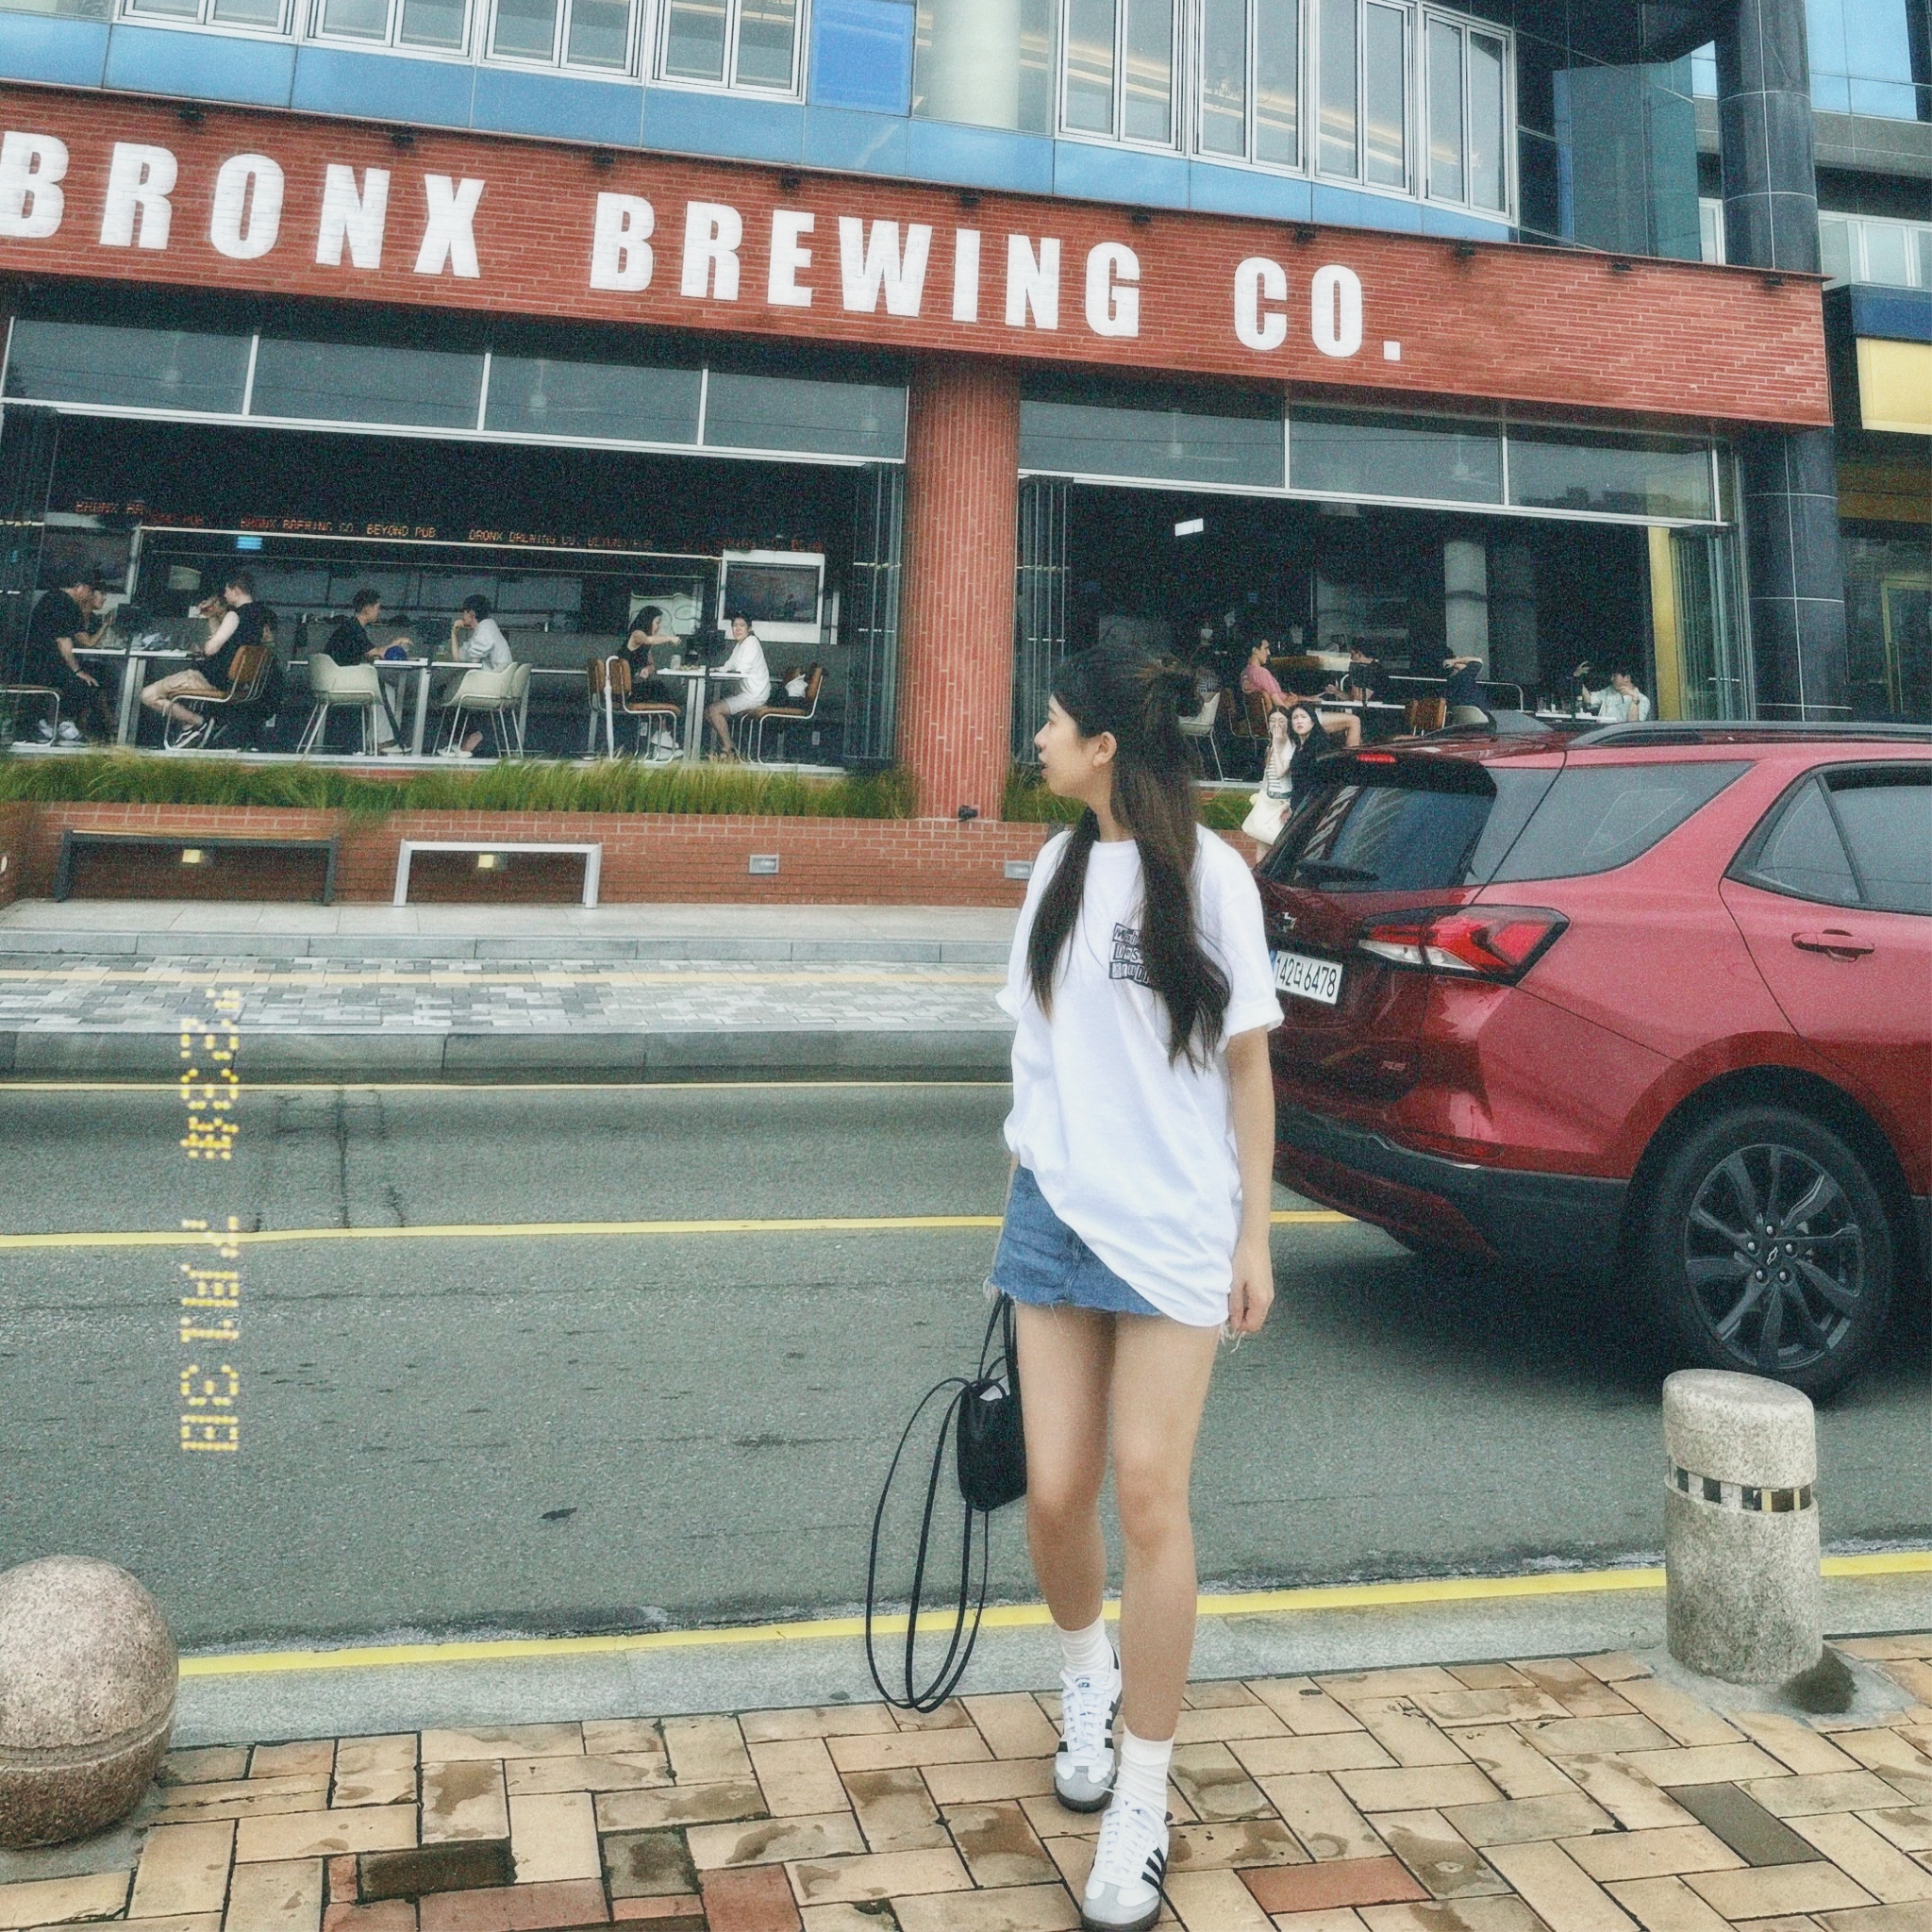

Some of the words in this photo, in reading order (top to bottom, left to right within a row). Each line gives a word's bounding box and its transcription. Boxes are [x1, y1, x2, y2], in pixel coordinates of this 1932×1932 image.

[0, 130, 485, 278] BRONX
[589, 192, 1141, 339] BREWING
[1234, 257, 1401, 361] CO.
